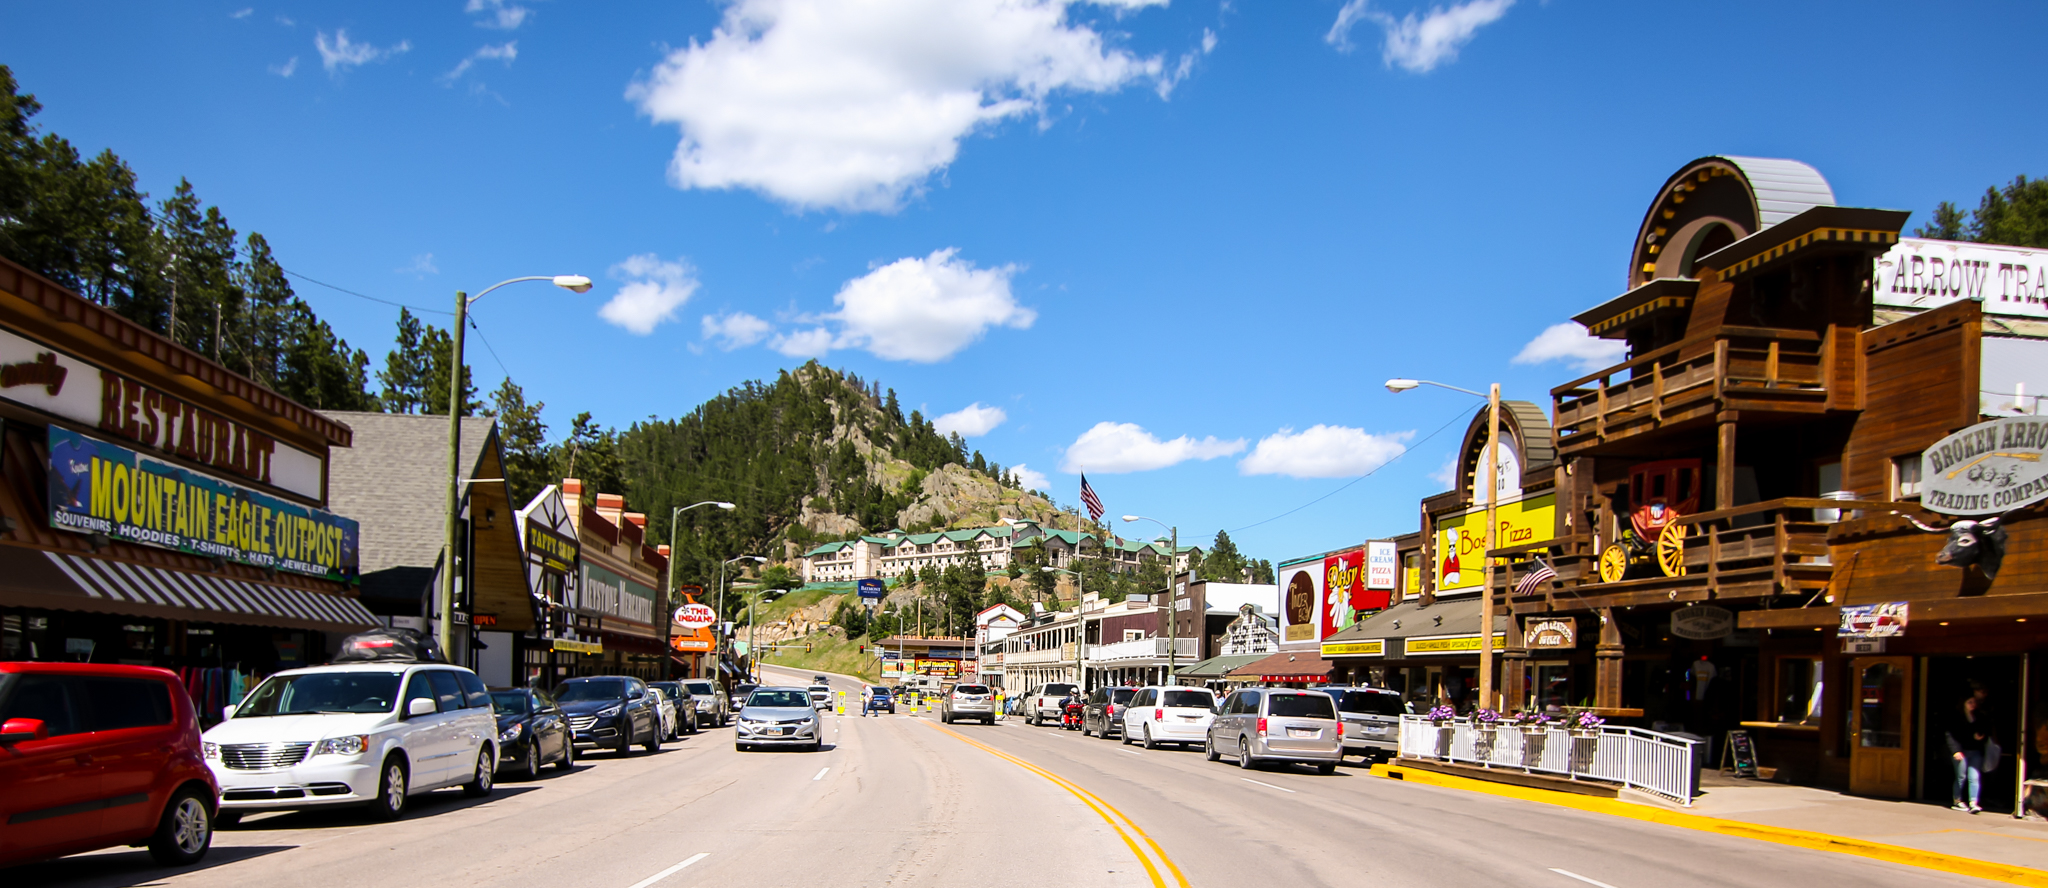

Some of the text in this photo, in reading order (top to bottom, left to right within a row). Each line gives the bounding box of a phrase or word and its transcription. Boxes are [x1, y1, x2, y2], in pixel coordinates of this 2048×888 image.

[1891, 254, 1989, 298] ARROW
[99, 369, 276, 484] RESTAURANT
[1929, 426, 1998, 475] BROKEN
[91, 456, 343, 569] MOUNTAIN EAGLE OUTPOST
[1928, 490, 1989, 510] TRADING
[55, 511, 330, 575] SOUVENIRS HOODIES T-SHIRTS HATS JEWELERY
[531, 528, 576, 562] TAFFY SHOP
[1500, 521, 1532, 549] Pizza
[582, 565, 652, 624] KEYSTONE MERCANTILE
[1176, 582, 1185, 596] THE
[1327, 562, 1358, 600] Daisy
[473, 615, 497, 625] OPEN
[690, 607, 708, 615] THE
